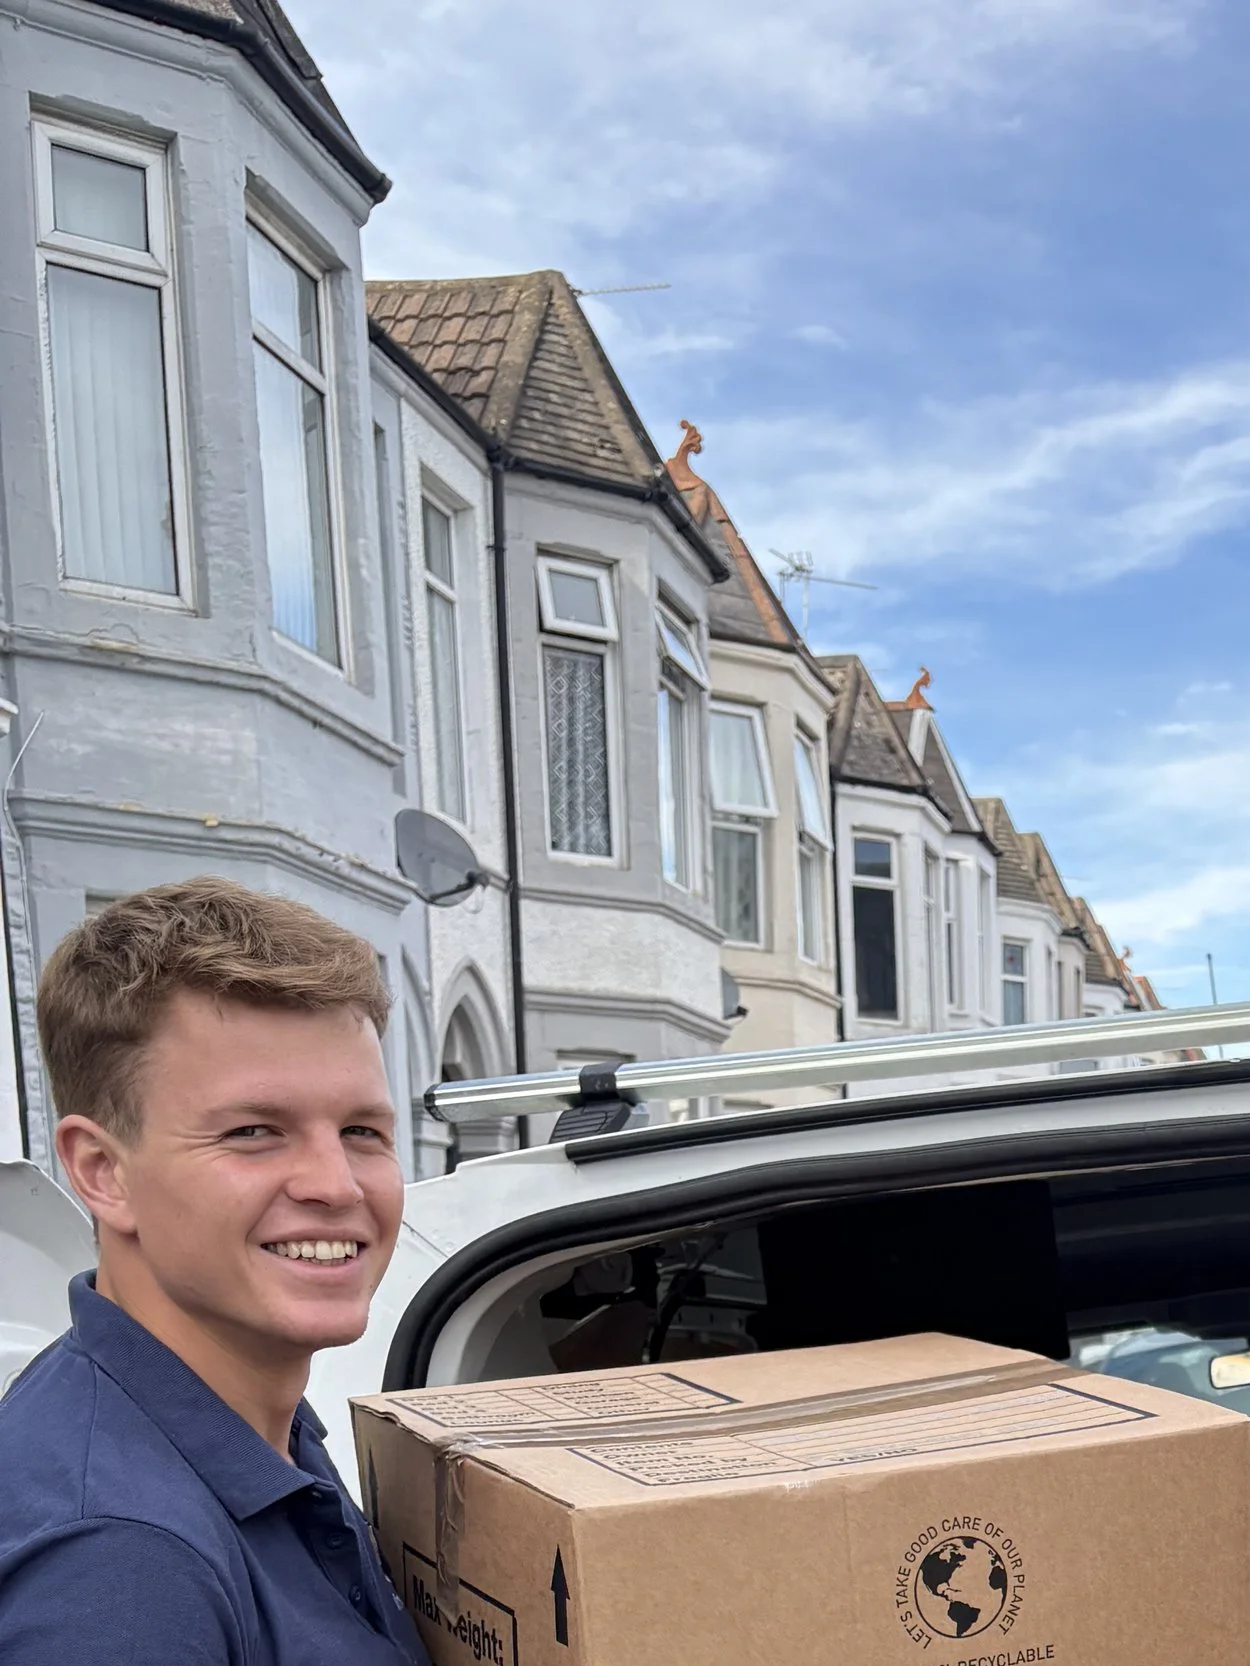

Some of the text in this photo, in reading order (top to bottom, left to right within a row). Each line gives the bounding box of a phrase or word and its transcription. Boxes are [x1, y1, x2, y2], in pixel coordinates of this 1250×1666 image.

[412, 1573, 442, 1627] Max
[895, 1516, 1026, 1650] LET'S TAKE GOOD CARE OF OUR PLANET
